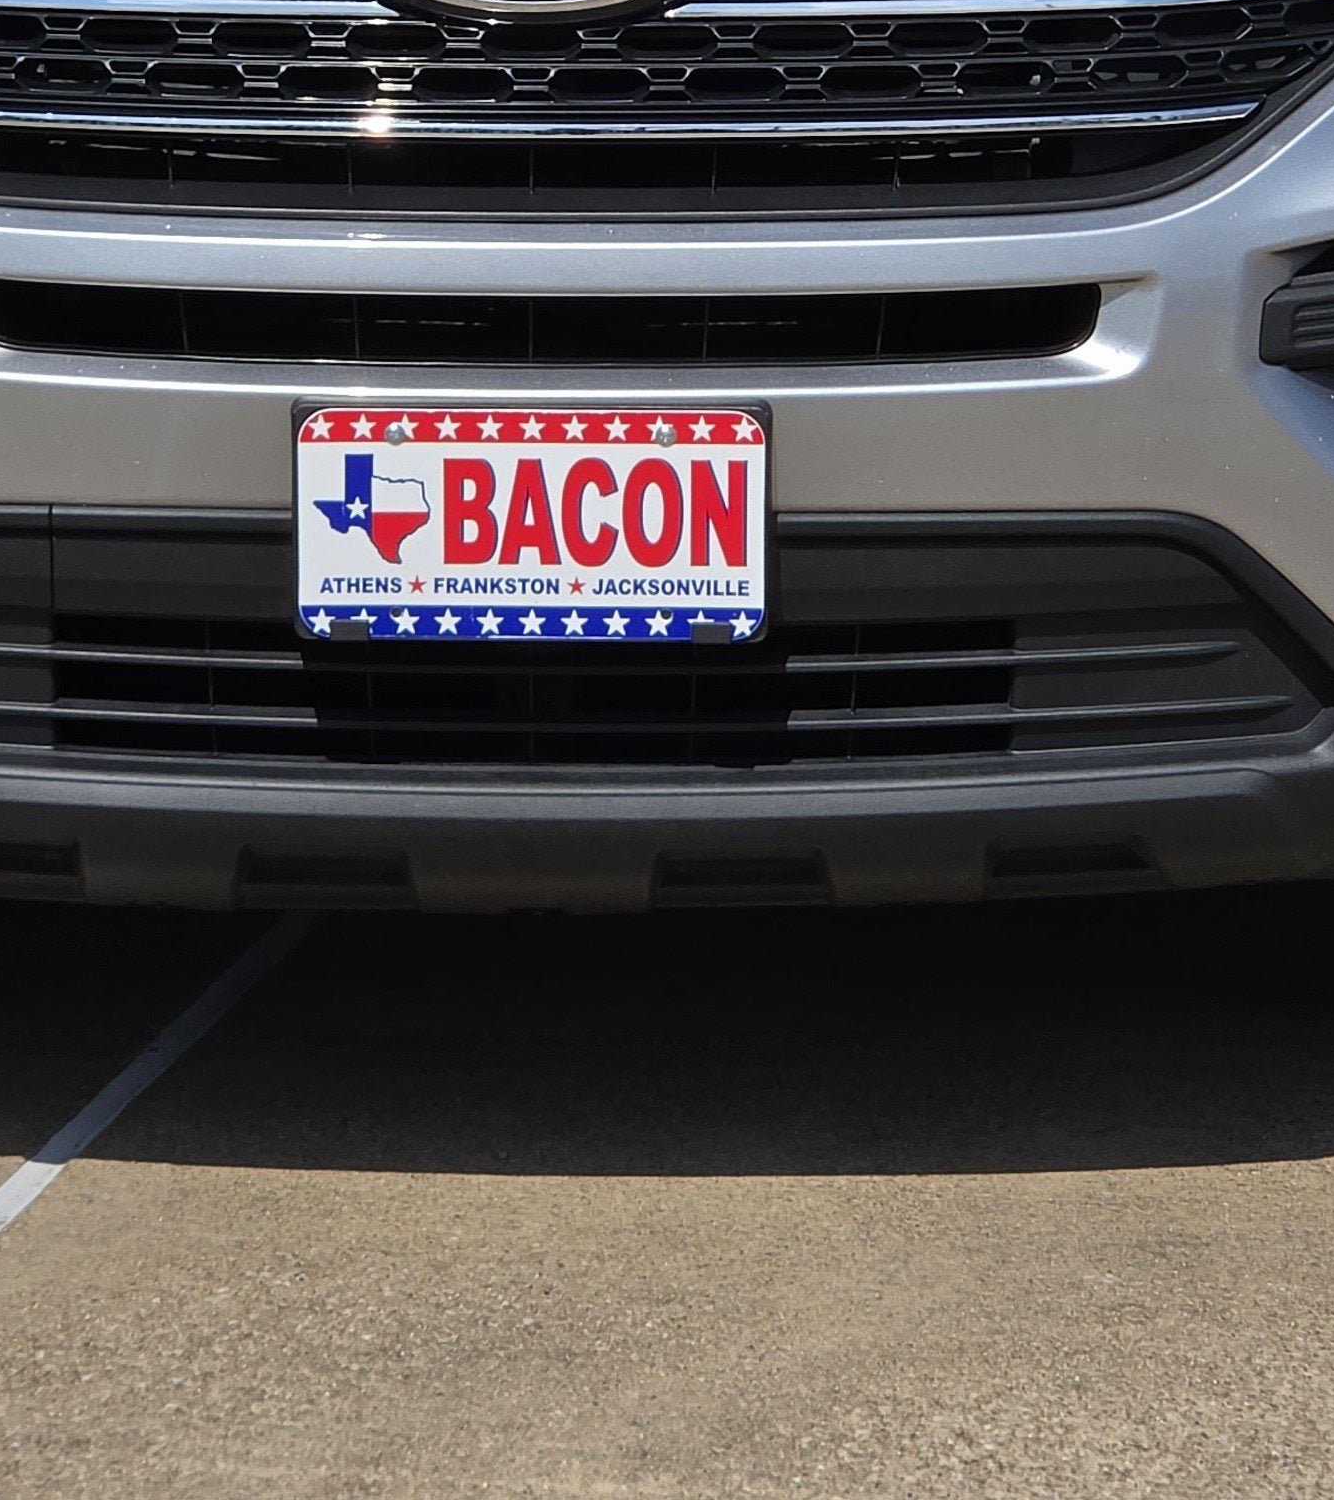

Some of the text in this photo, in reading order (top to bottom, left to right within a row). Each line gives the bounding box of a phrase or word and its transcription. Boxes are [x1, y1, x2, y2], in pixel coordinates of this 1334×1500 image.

[443, 457, 748, 568] BACON
[319, 576, 751, 597] ATHENS FRANKSTON JACKSONVILLE
